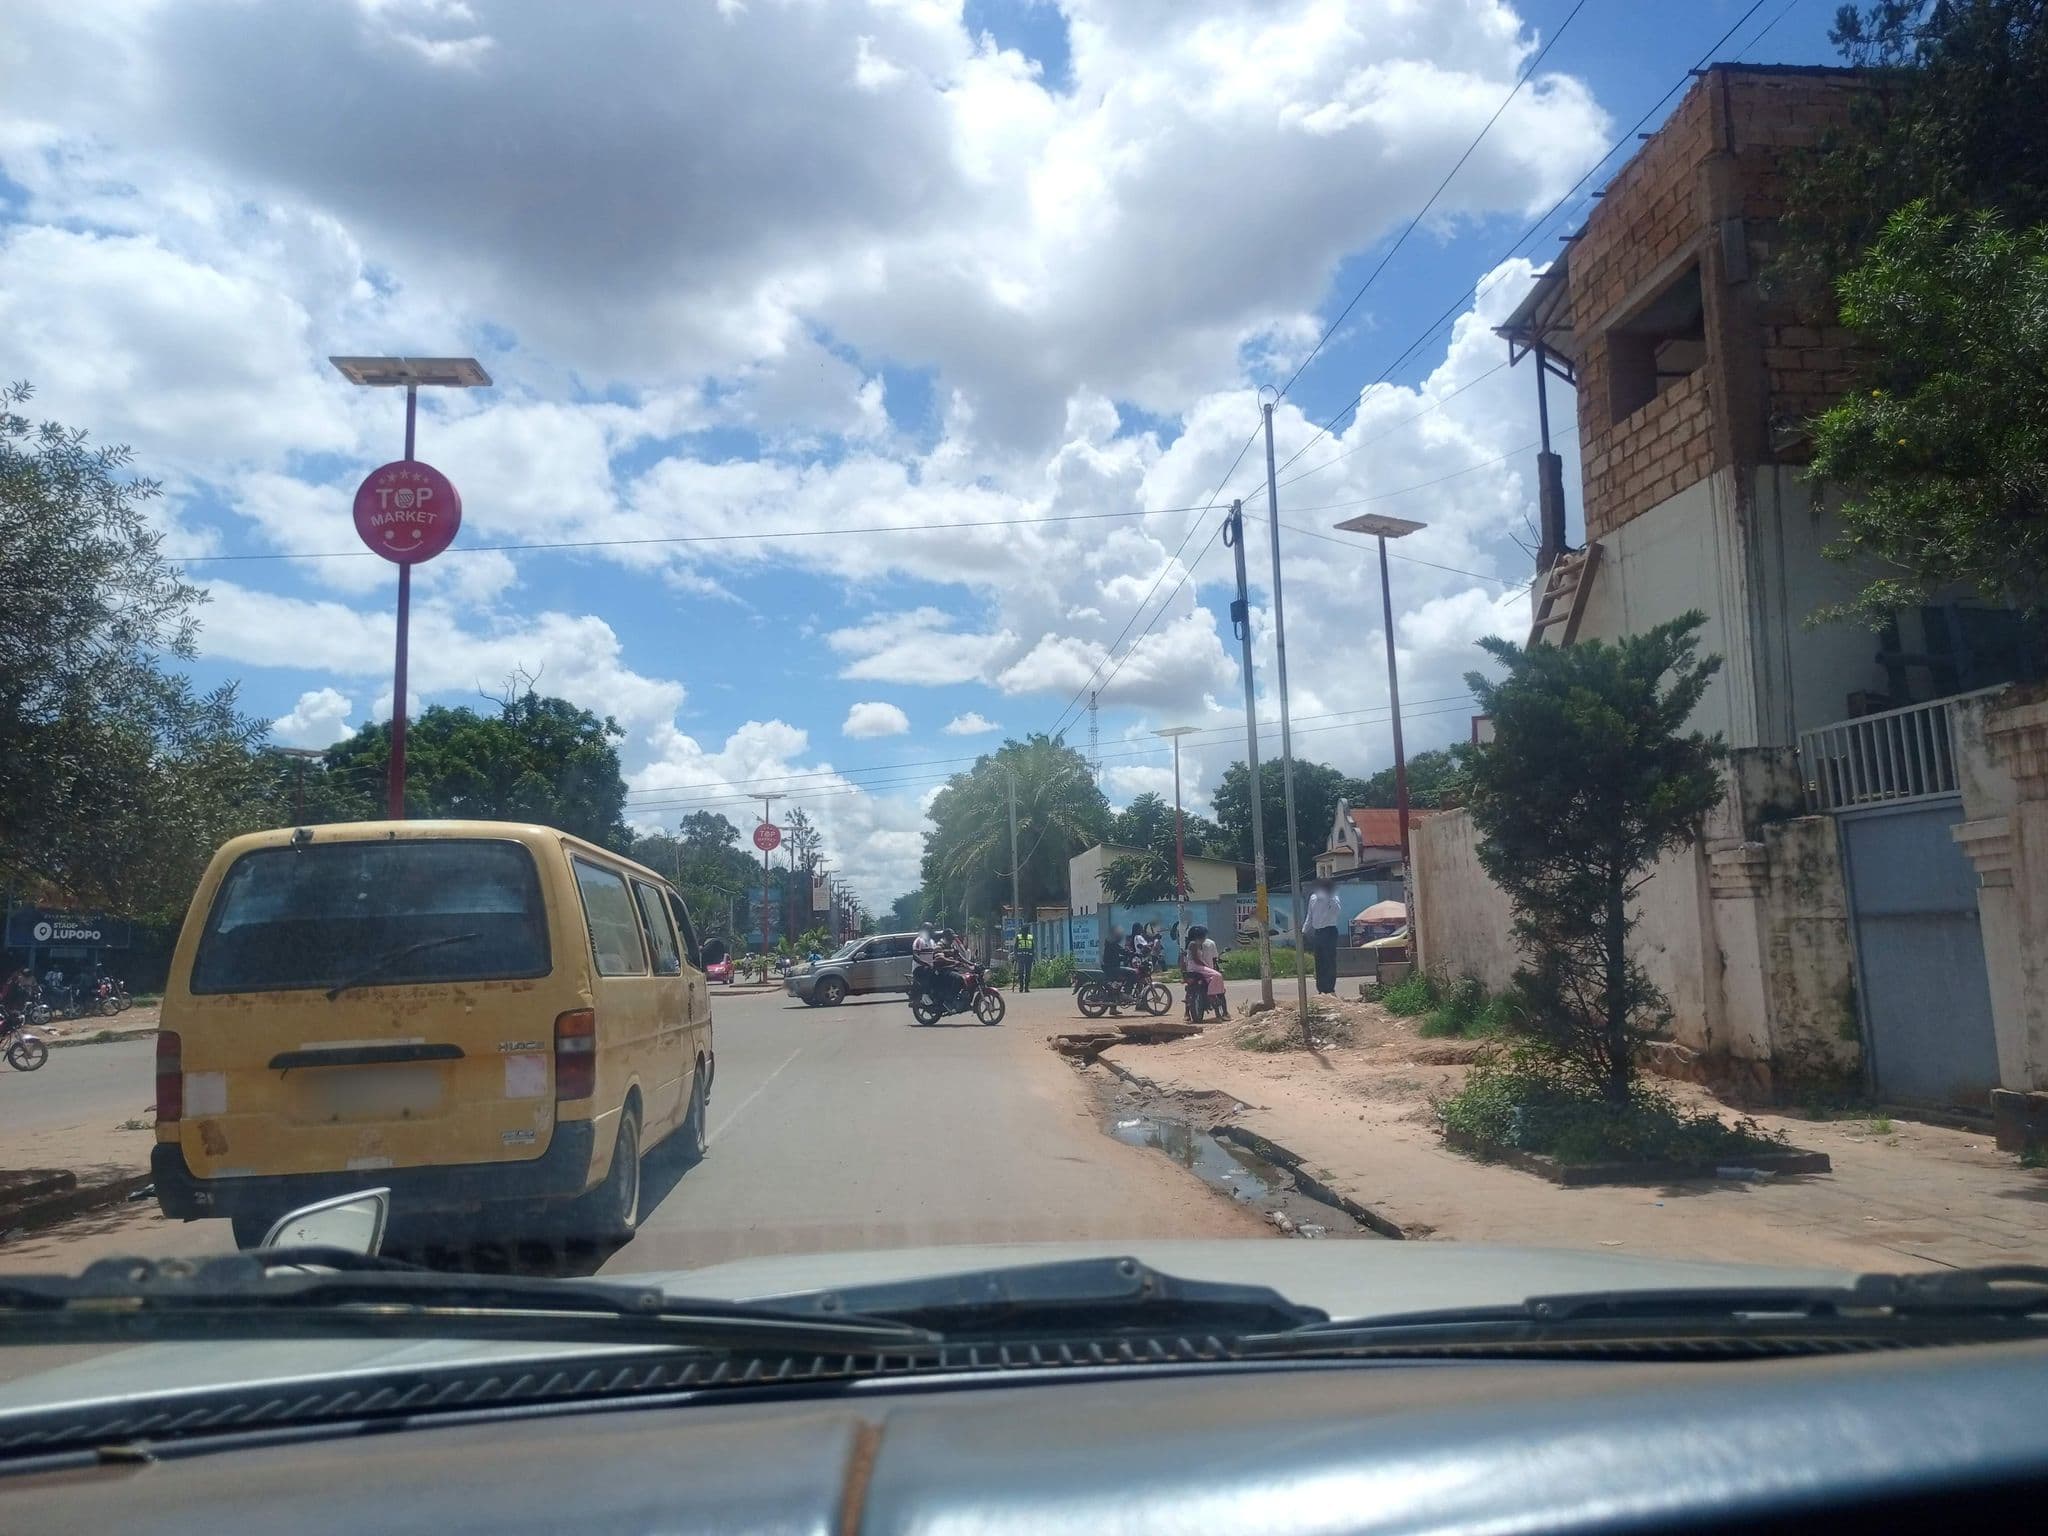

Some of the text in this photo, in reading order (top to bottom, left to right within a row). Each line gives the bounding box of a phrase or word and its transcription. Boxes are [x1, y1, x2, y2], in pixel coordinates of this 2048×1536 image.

[375, 487, 433, 509] TOP
[370, 511, 438, 527] MARKET
[760, 830, 776, 838] TOP
[53, 929, 101, 940] LUPOPO
